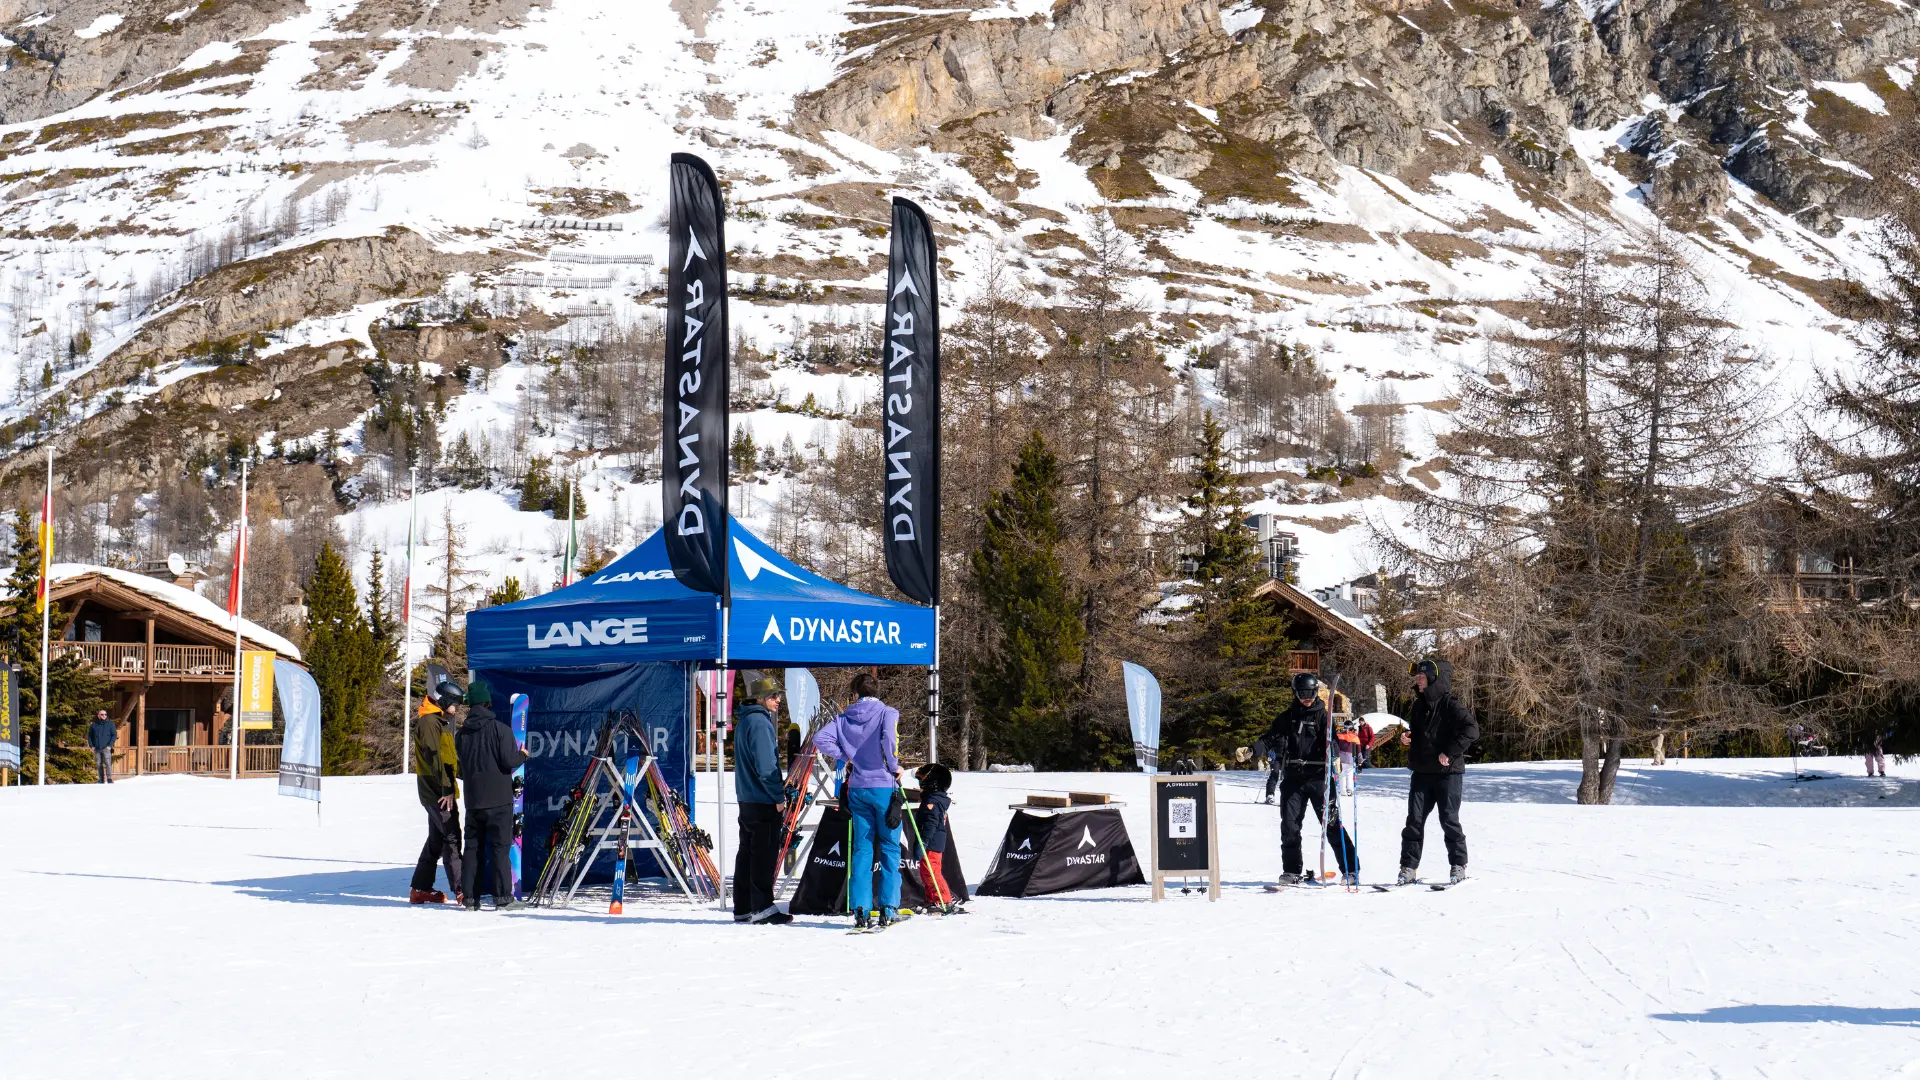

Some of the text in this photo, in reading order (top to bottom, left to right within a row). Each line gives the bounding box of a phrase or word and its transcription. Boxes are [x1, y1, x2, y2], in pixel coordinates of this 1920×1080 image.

[592, 569, 677, 585] LANG
[527, 617, 648, 649] LANGE
[789, 617, 901, 645] DYNASTAR
[252, 656, 262, 699] OXYGENE
[527, 727, 669, 758] DYNATR
[814, 856, 846, 868] DYNASTAR
[1006, 852, 1037, 860] DYNAST
